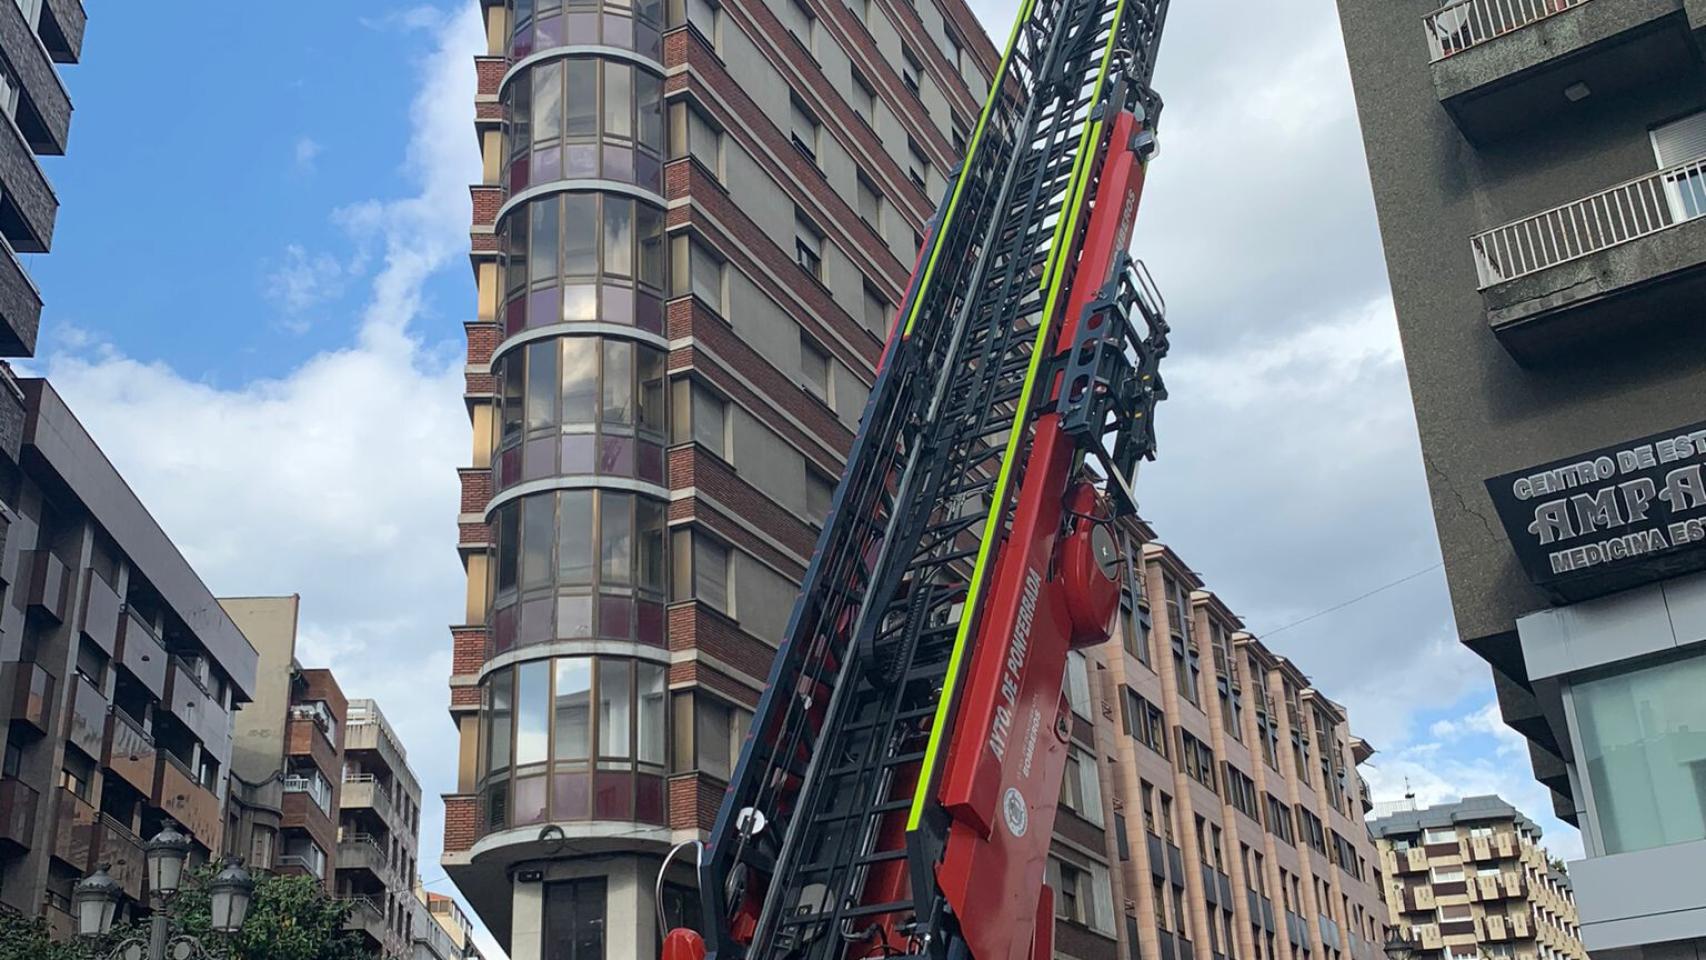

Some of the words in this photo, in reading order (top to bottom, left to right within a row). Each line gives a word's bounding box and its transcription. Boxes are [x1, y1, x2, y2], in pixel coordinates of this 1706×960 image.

[1111, 188, 1135, 274] MBEROS
[1513, 455, 1616, 500] CENTRO
[1616, 444, 1657, 475] DE
[1527, 463, 1706, 546] AMPA
[1549, 528, 1669, 575] MEDICINA
[1007, 567, 1042, 681] PONFERRADA
[1001, 672, 1018, 707] DE
[989, 704, 1012, 763] AYTO.
[1022, 710, 1042, 779] BOMBEROS
